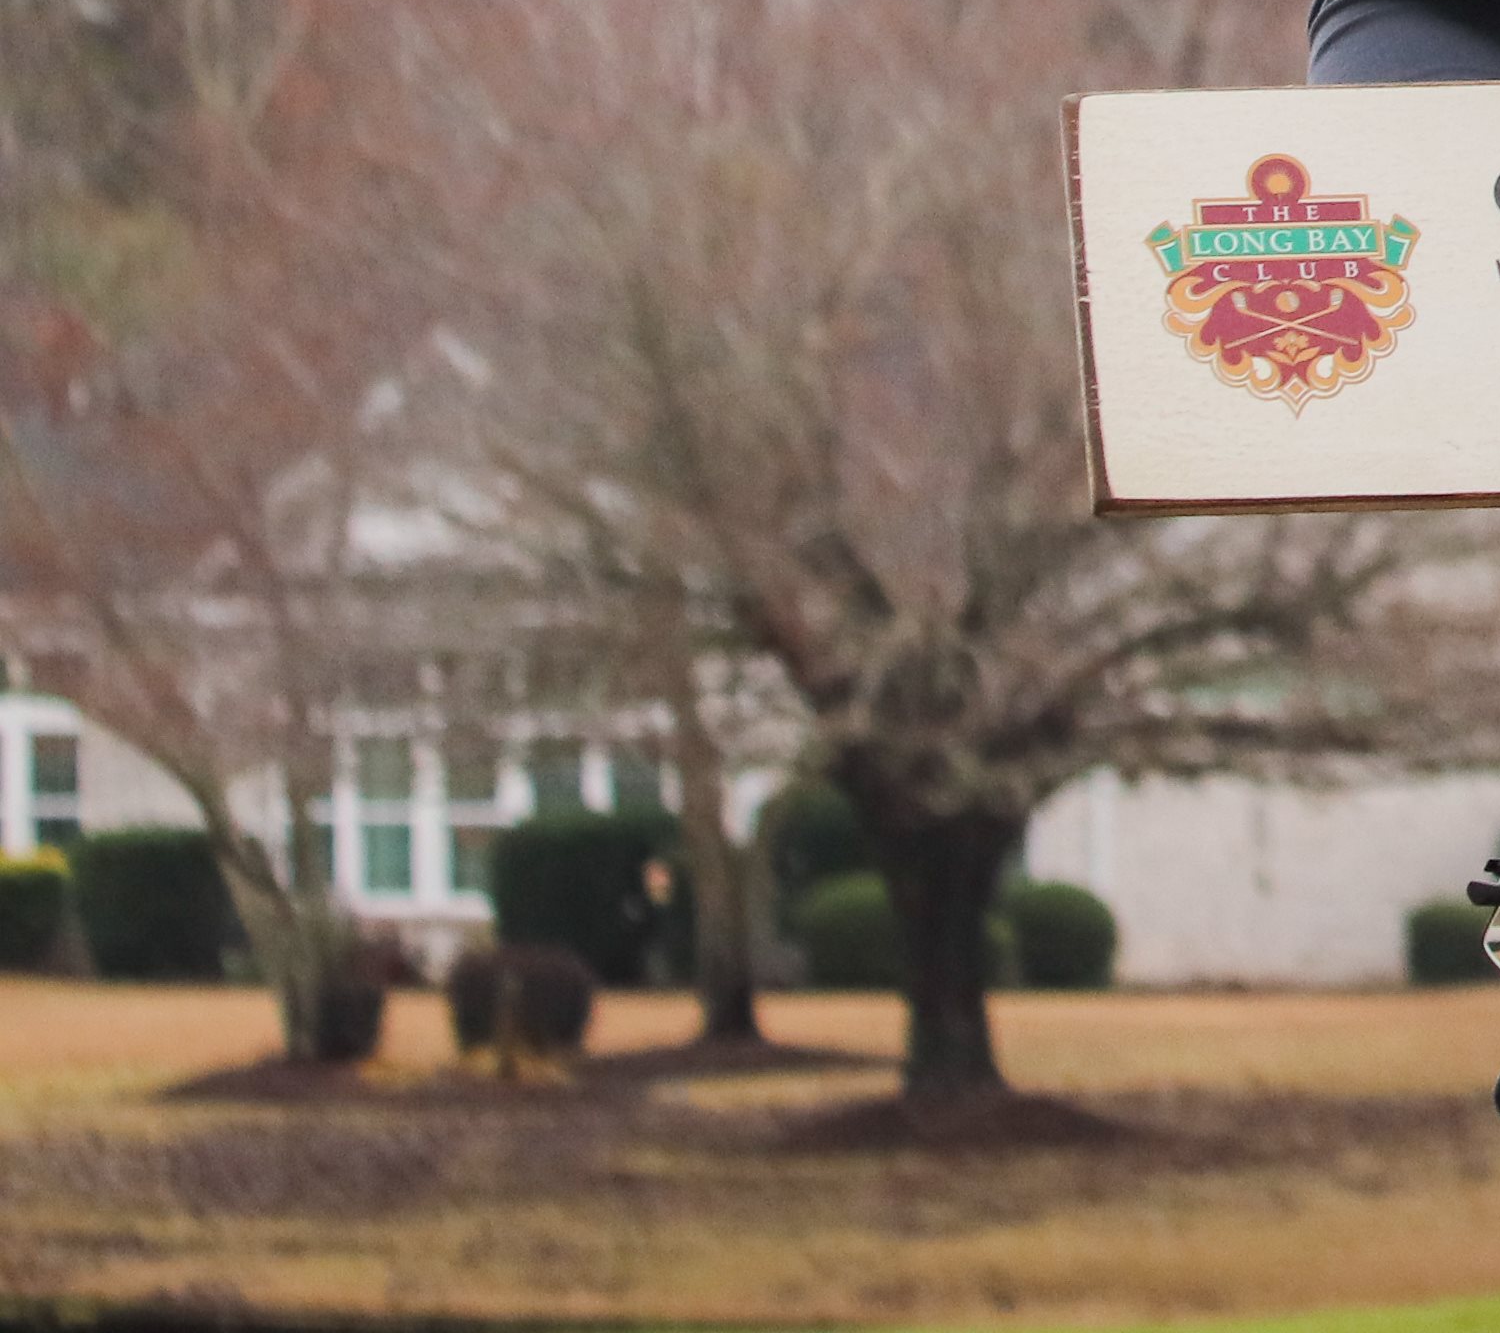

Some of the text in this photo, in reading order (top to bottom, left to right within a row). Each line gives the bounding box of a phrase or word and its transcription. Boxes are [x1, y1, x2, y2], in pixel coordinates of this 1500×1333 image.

[1243, 204, 1320, 223] THE
[1192, 226, 1374, 255] LONG BAY
[1212, 260, 1360, 282] CLUB
